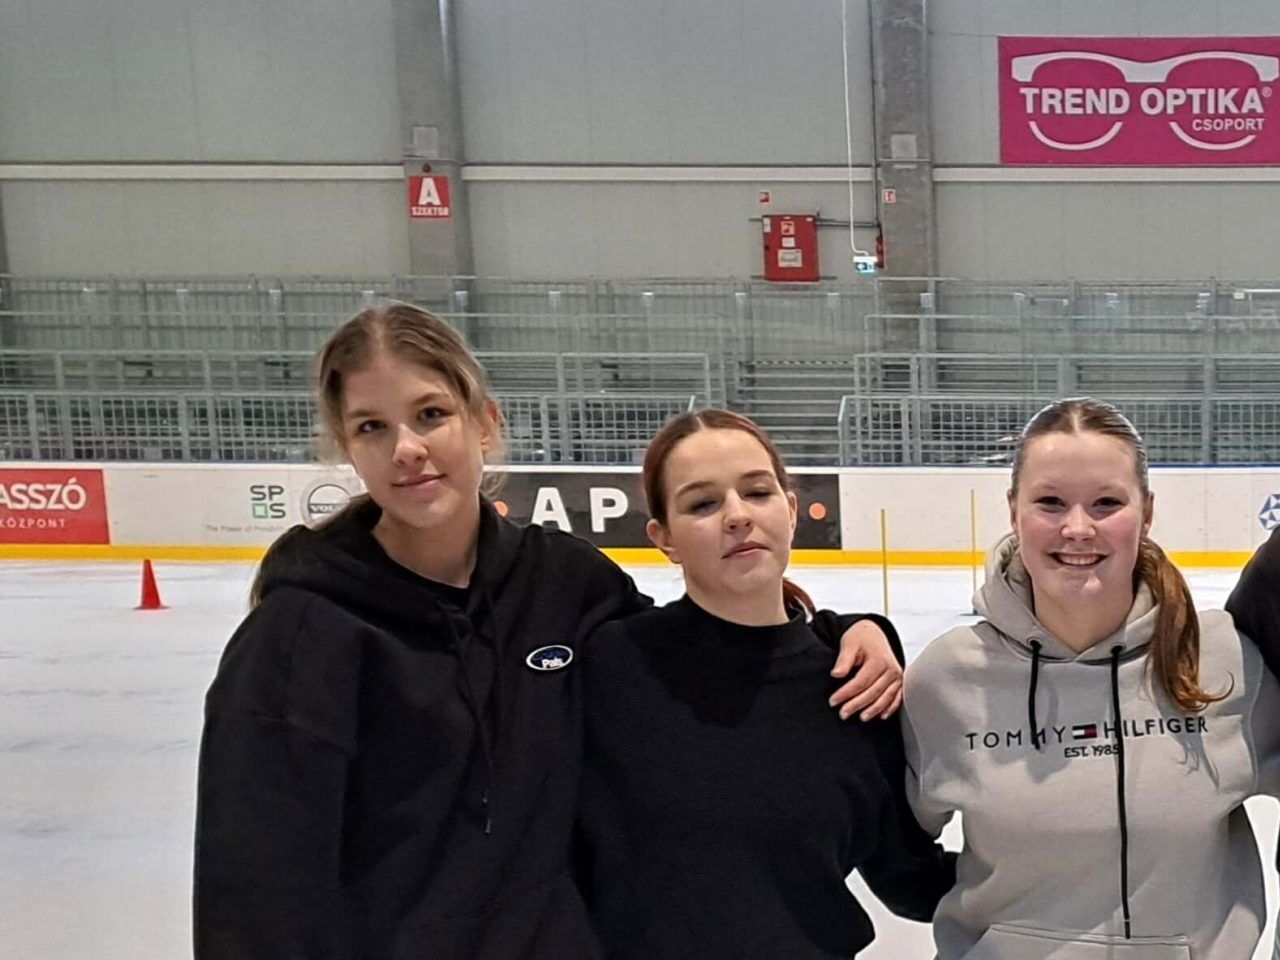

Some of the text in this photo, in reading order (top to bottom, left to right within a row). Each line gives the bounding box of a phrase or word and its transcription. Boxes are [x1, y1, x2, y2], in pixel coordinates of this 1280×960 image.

[1019, 87, 1130, 115] TREND
[1192, 118, 1265, 131] CSOPORT
[418, 177, 441, 205] A
[0, 477, 87, 511] ASSZÓ
[310, 504, 336, 513] VOL
[531, 487, 629, 533] AP
[1104, 717, 1209, 739] HILFIGER
